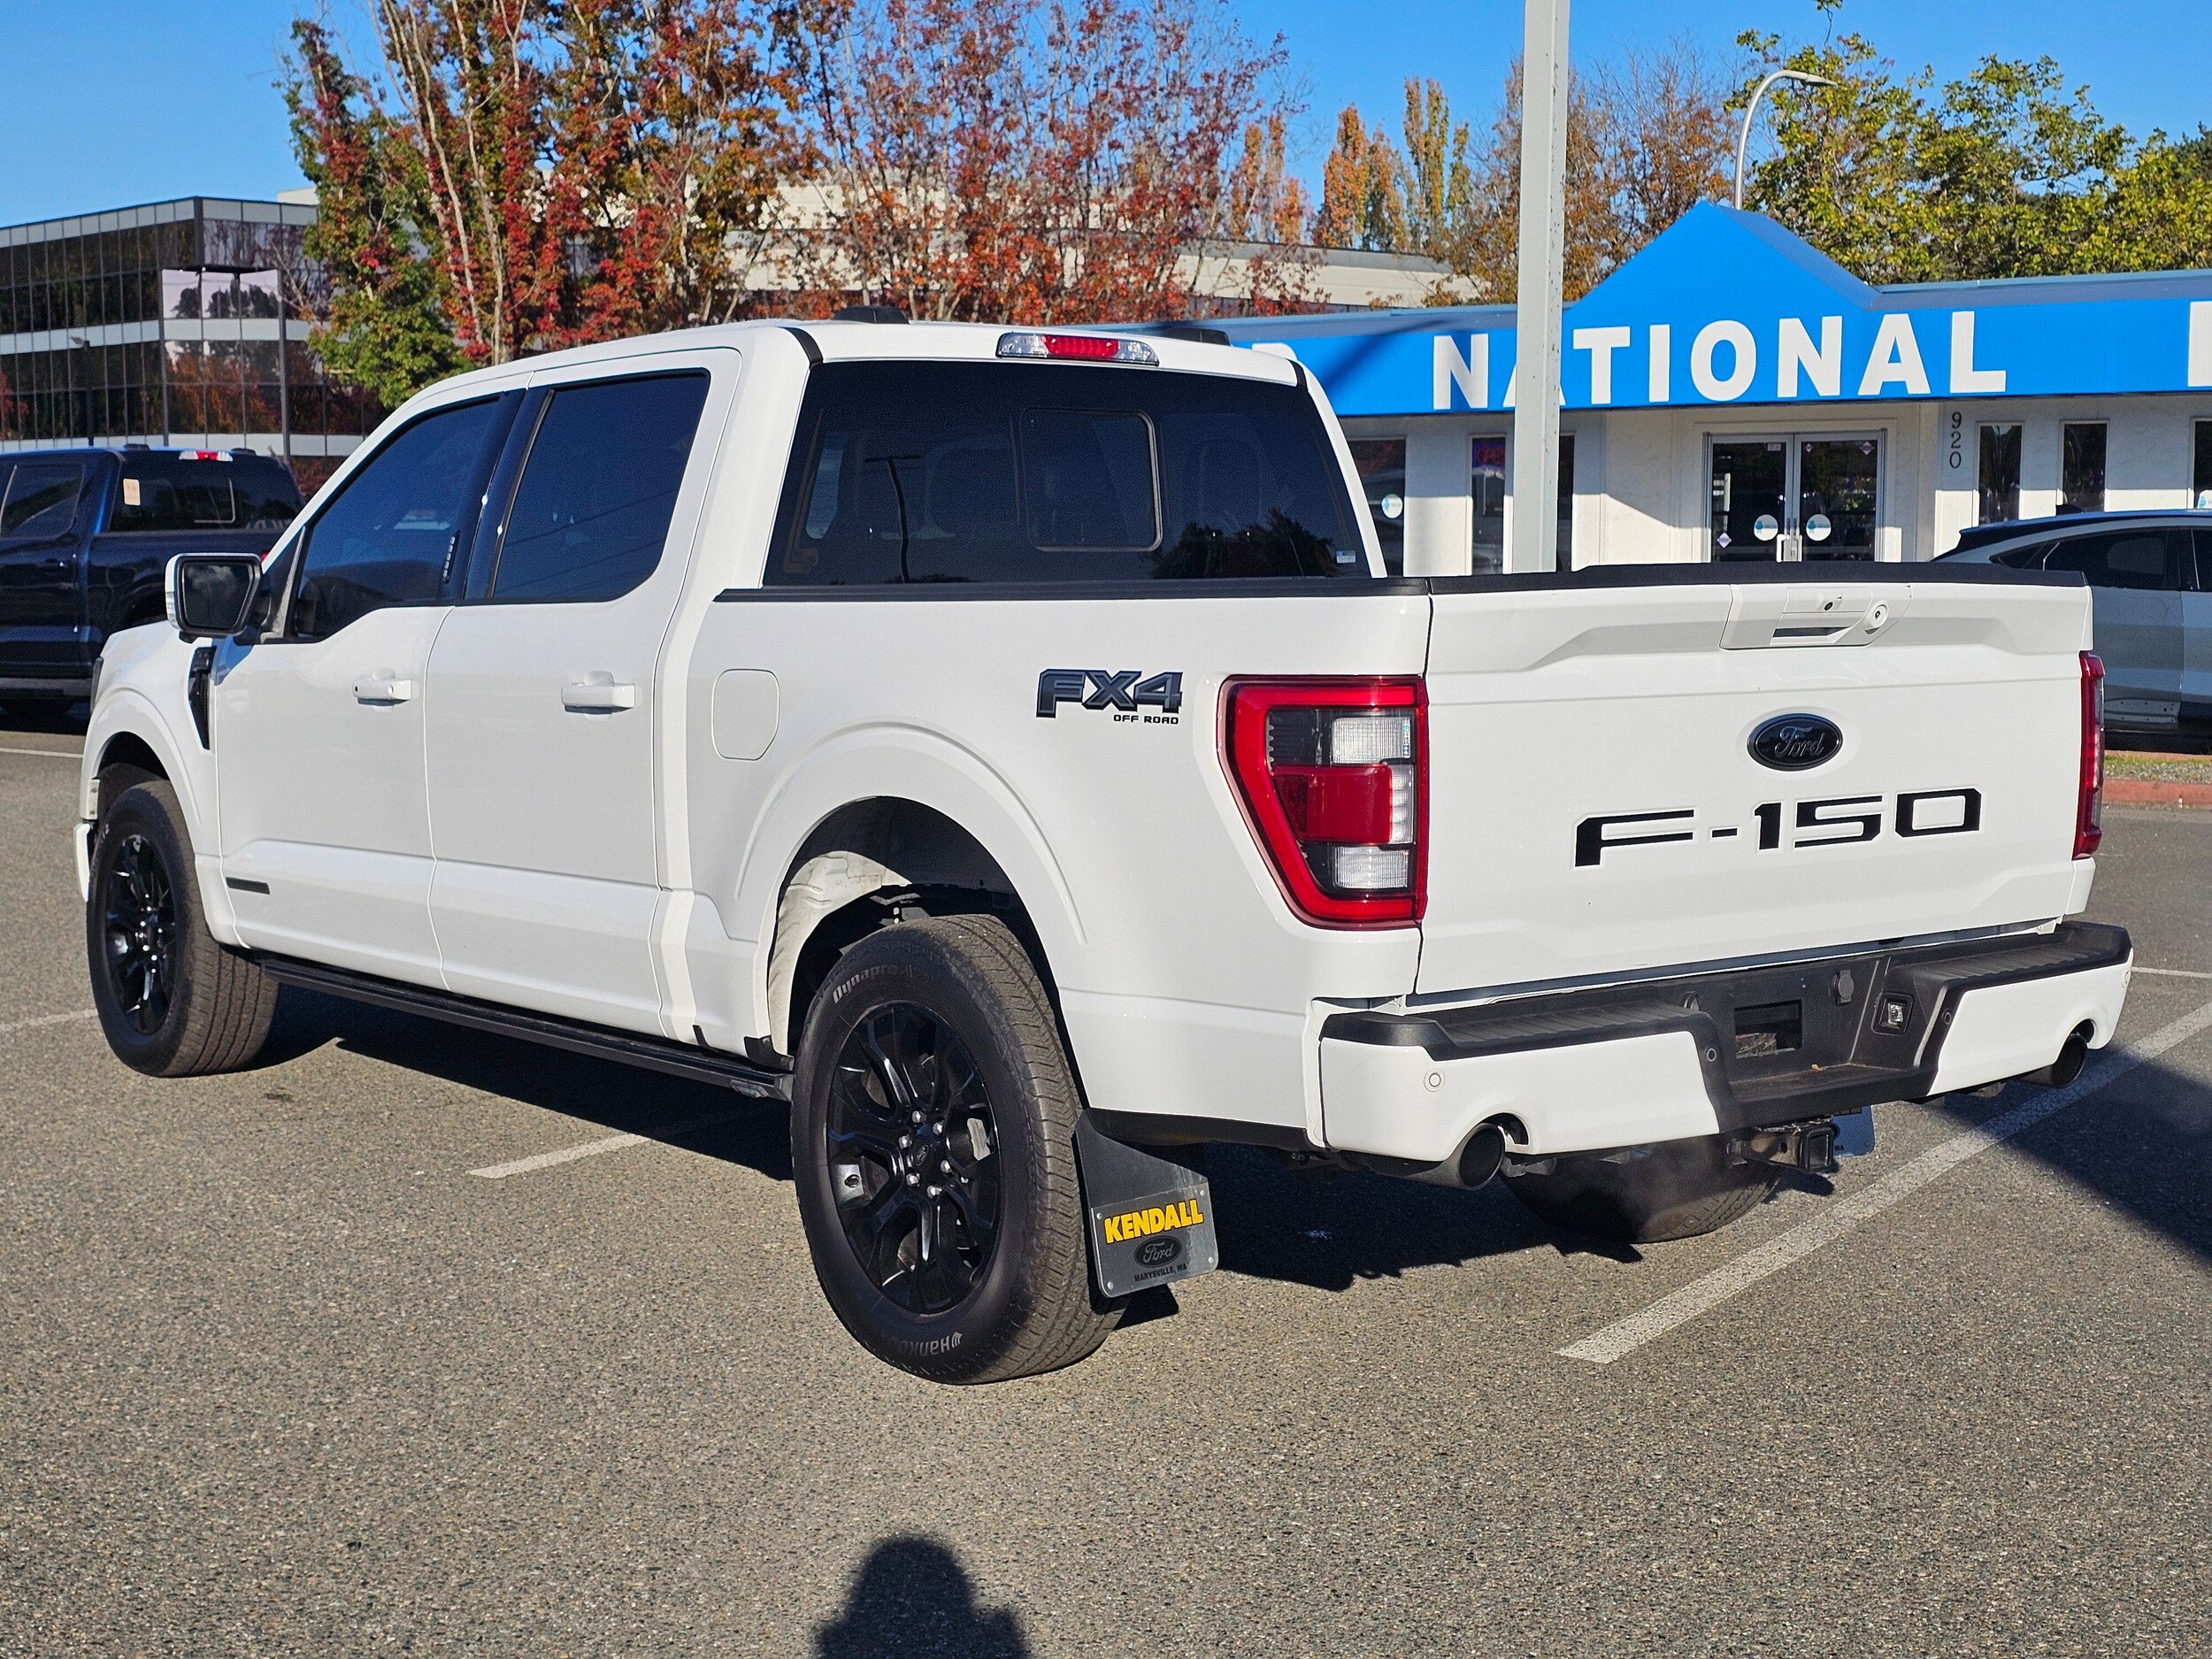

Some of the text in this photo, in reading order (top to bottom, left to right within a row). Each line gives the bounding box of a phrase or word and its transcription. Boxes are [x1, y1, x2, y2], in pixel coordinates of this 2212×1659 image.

[1432, 311, 2007, 411] NTIONAL
[1477, 447, 1505, 465] OPE
[1949, 411, 1962, 469] 920
[1036, 669, 1183, 718] FX4
[1113, 714, 1179, 725] OFF ROAD
[1774, 726, 1825, 758] Ford
[1574, 787, 1983, 867] F-150
[1104, 1198, 1204, 1244] KENDALL
[1142, 1241, 1174, 1263] Ford
